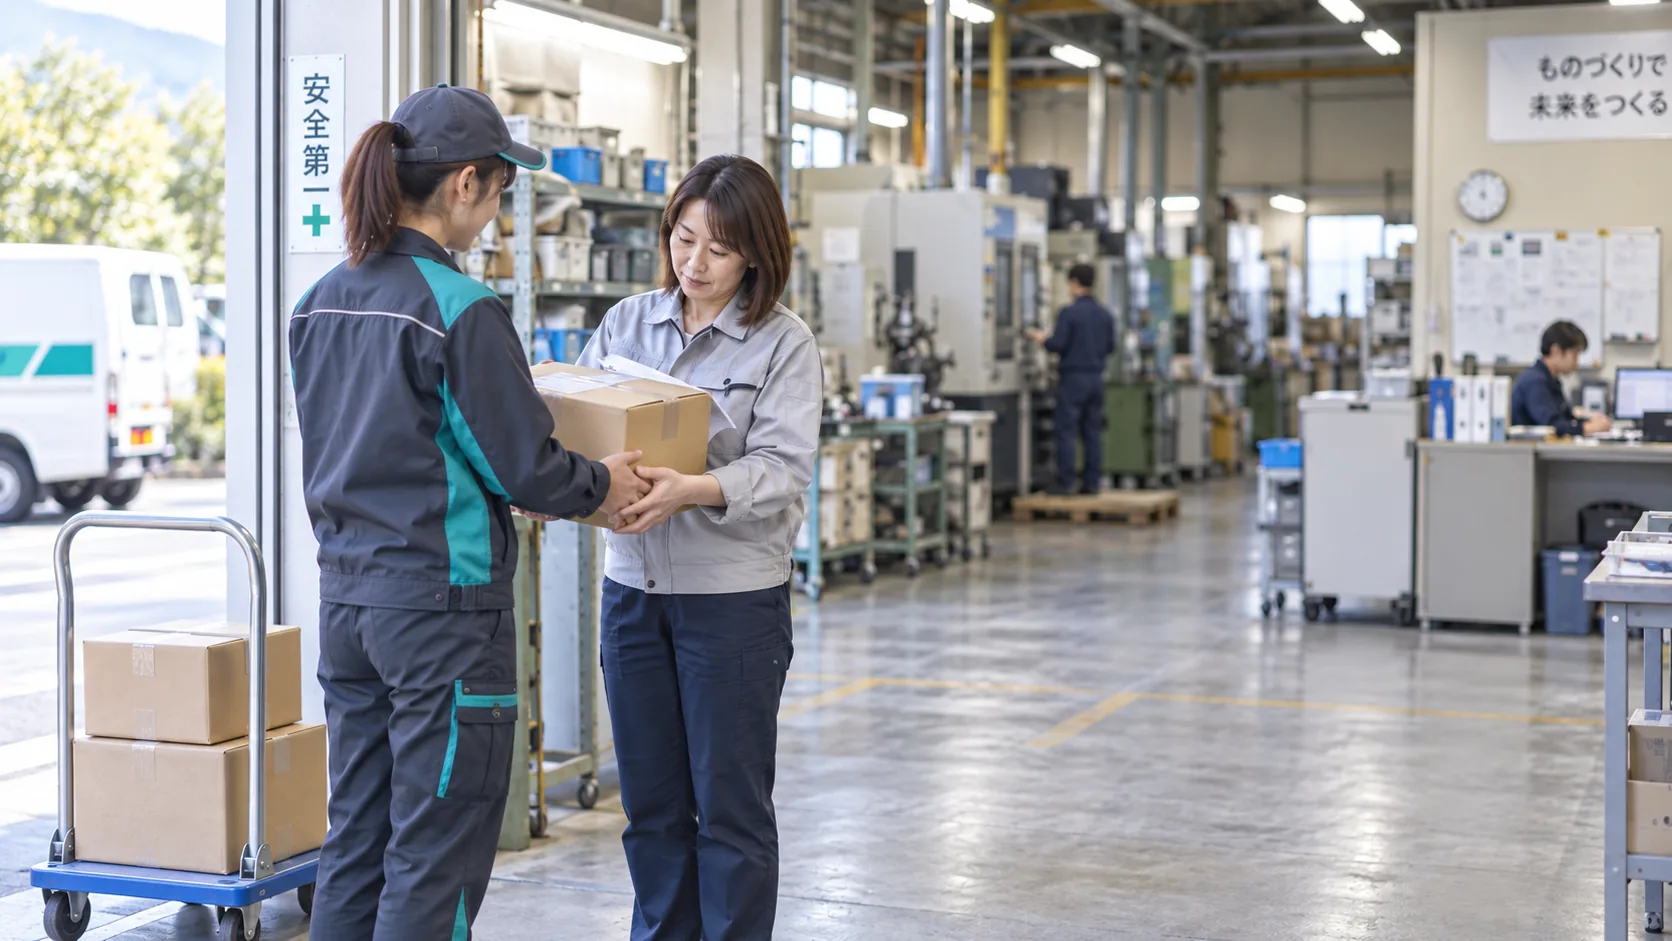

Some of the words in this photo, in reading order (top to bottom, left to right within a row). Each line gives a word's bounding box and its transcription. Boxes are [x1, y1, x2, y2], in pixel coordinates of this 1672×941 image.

[1538, 54, 1666, 81] ものづくりで
[1530, 90, 1668, 119] 未来をつくる
[303, 72, 330, 192] 安全第一
